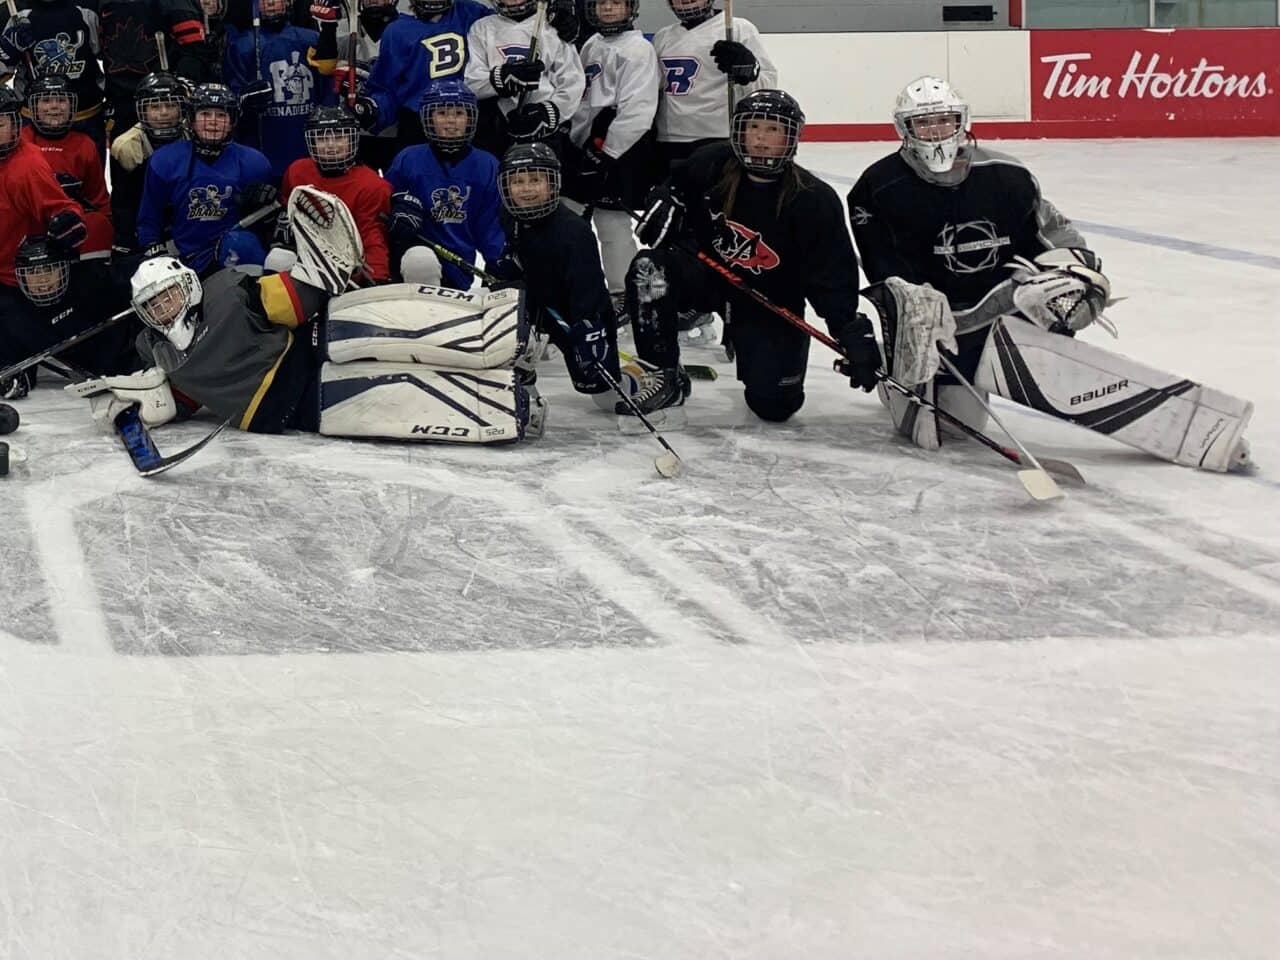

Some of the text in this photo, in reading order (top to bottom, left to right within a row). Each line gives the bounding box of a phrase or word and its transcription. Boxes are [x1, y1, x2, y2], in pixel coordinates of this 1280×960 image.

[422, 32, 466, 79] B
[659, 56, 702, 96] R
[1040, 50, 1267, 99] Tim Hortons
[417, 285, 475, 302] CCM
[1070, 379, 1129, 406] BAUER
[410, 425, 470, 437] CCM
